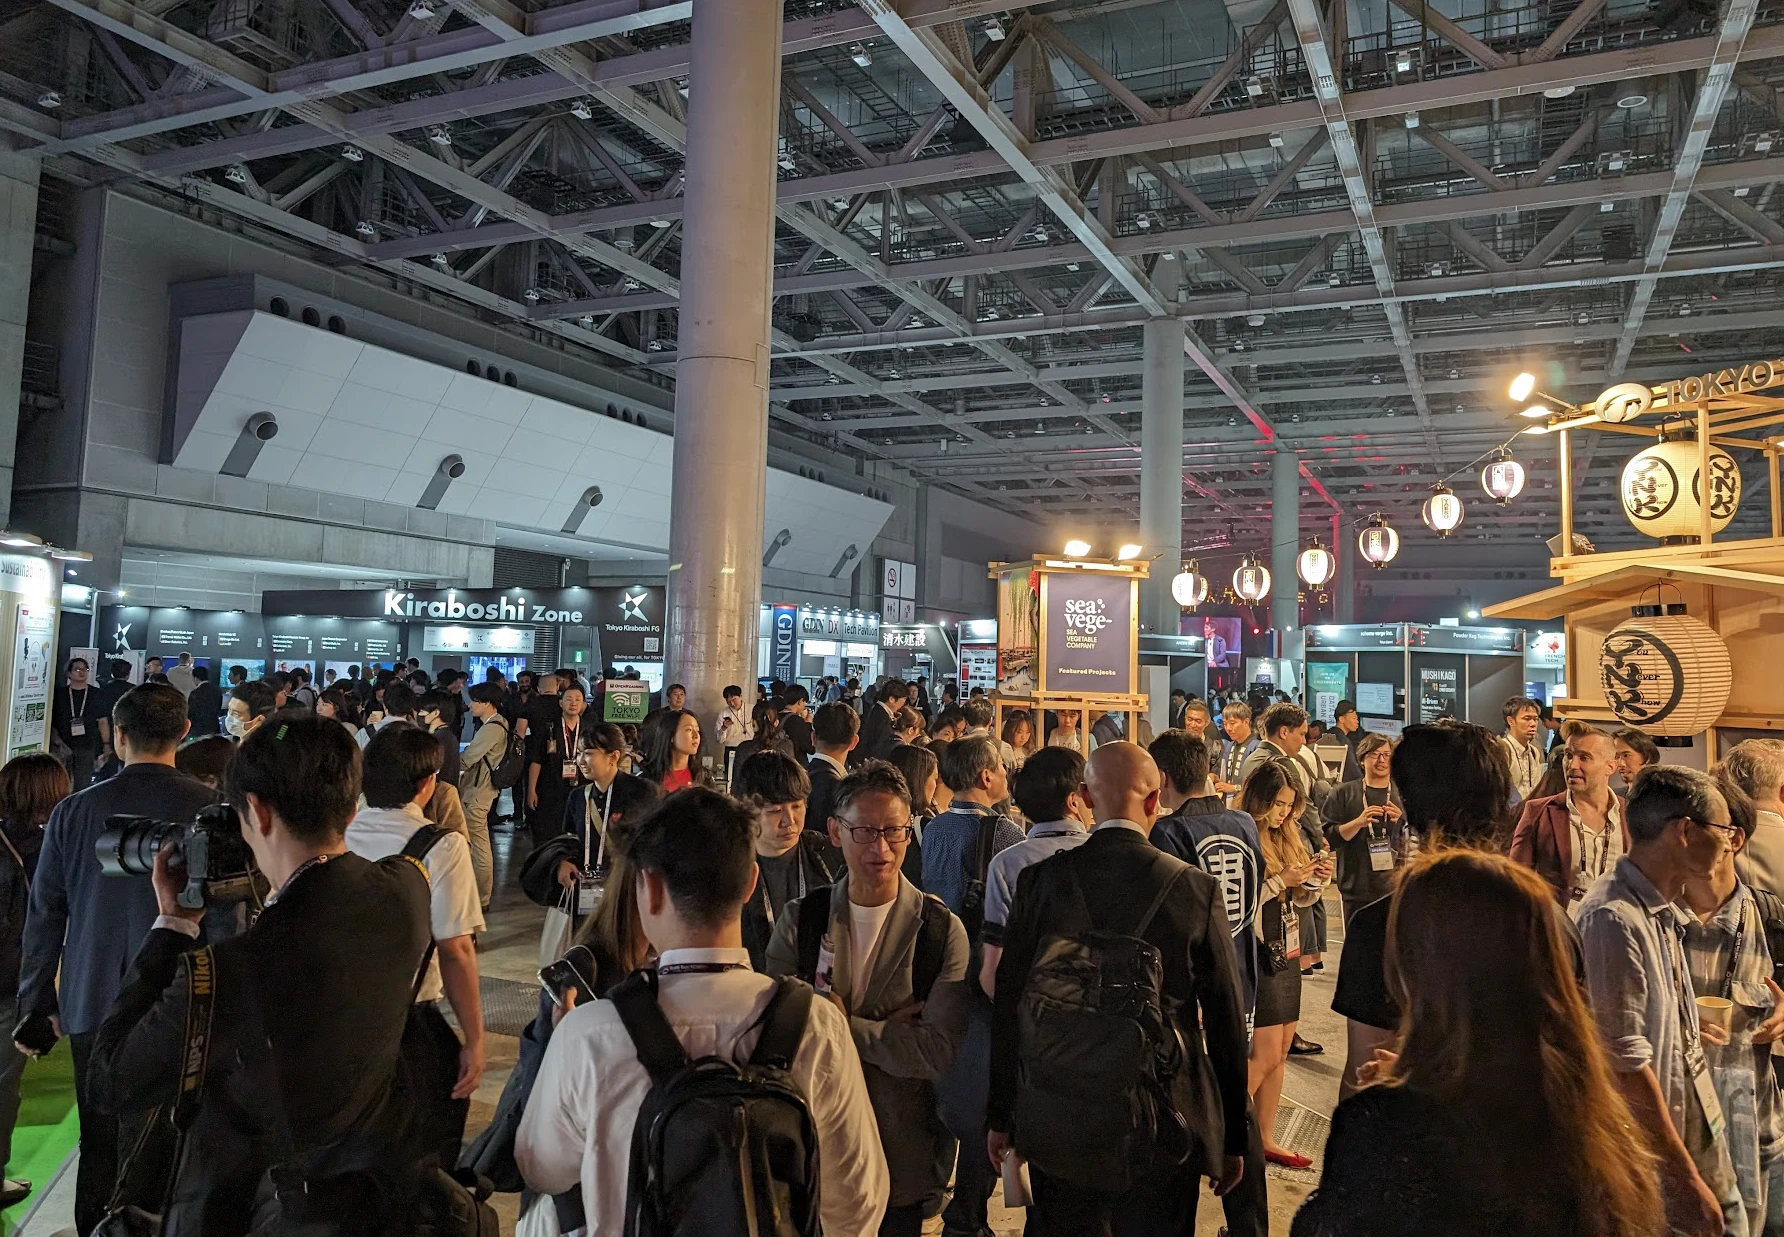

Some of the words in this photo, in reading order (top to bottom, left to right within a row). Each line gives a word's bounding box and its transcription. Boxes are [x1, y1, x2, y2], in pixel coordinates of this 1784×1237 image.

[1661, 360, 1774, 405] TOKYO
[384, 592, 526, 621] Kiraboshi
[531, 606, 583, 622] Zone
[1065, 599, 1097, 614] sea
[605, 624, 623, 632] Tokyo
[828, 619, 839, 634] DX
[844, 622, 856, 635] Tech
[857, 624, 878, 636] Pavilion
[776, 613, 793, 669] GDIN
[883, 632, 927, 647] 清水建設
[1066, 635, 1098, 643] VEGETABLE
[1059, 667, 1088, 675] Featured
